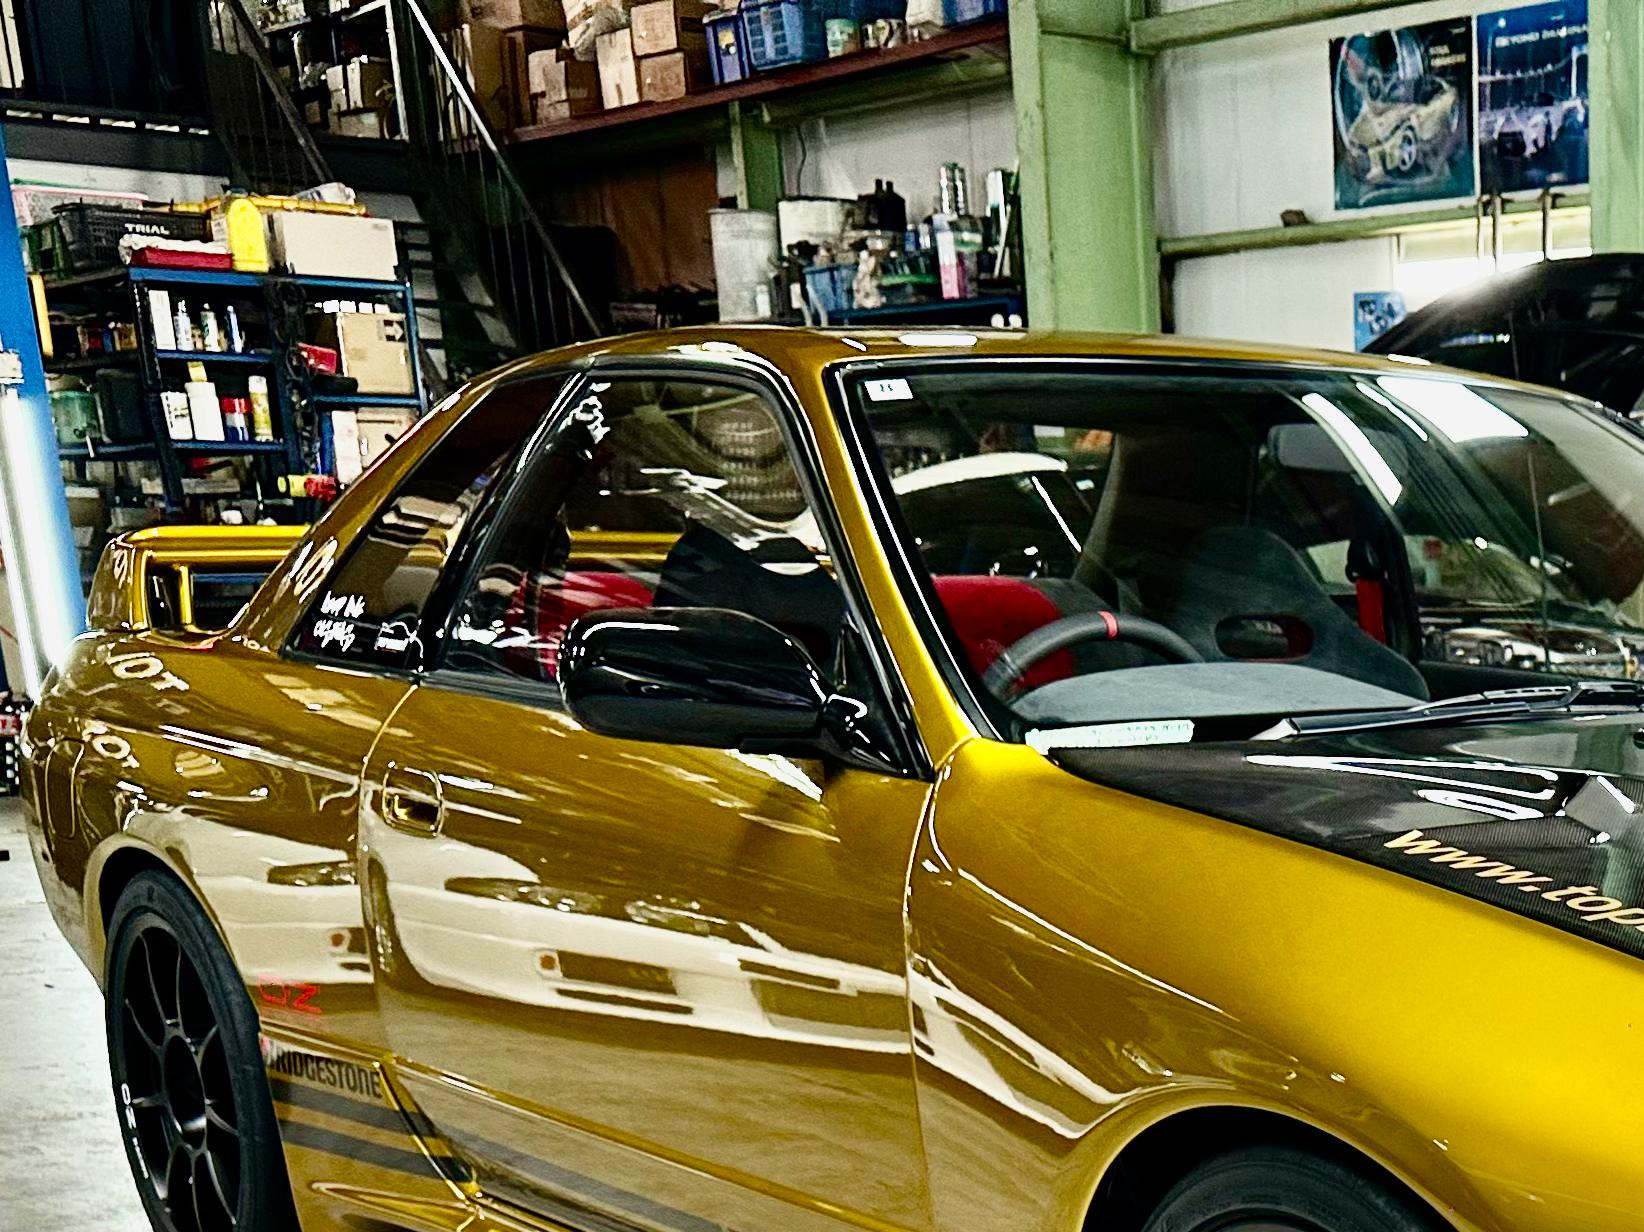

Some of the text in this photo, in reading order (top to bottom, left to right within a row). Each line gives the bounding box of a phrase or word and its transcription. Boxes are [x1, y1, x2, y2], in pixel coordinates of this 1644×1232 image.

[124, 223, 170, 236] TRIAL
[257, 974, 322, 1014] OZ
[268, 1048, 383, 1099] RIDGESTONE
